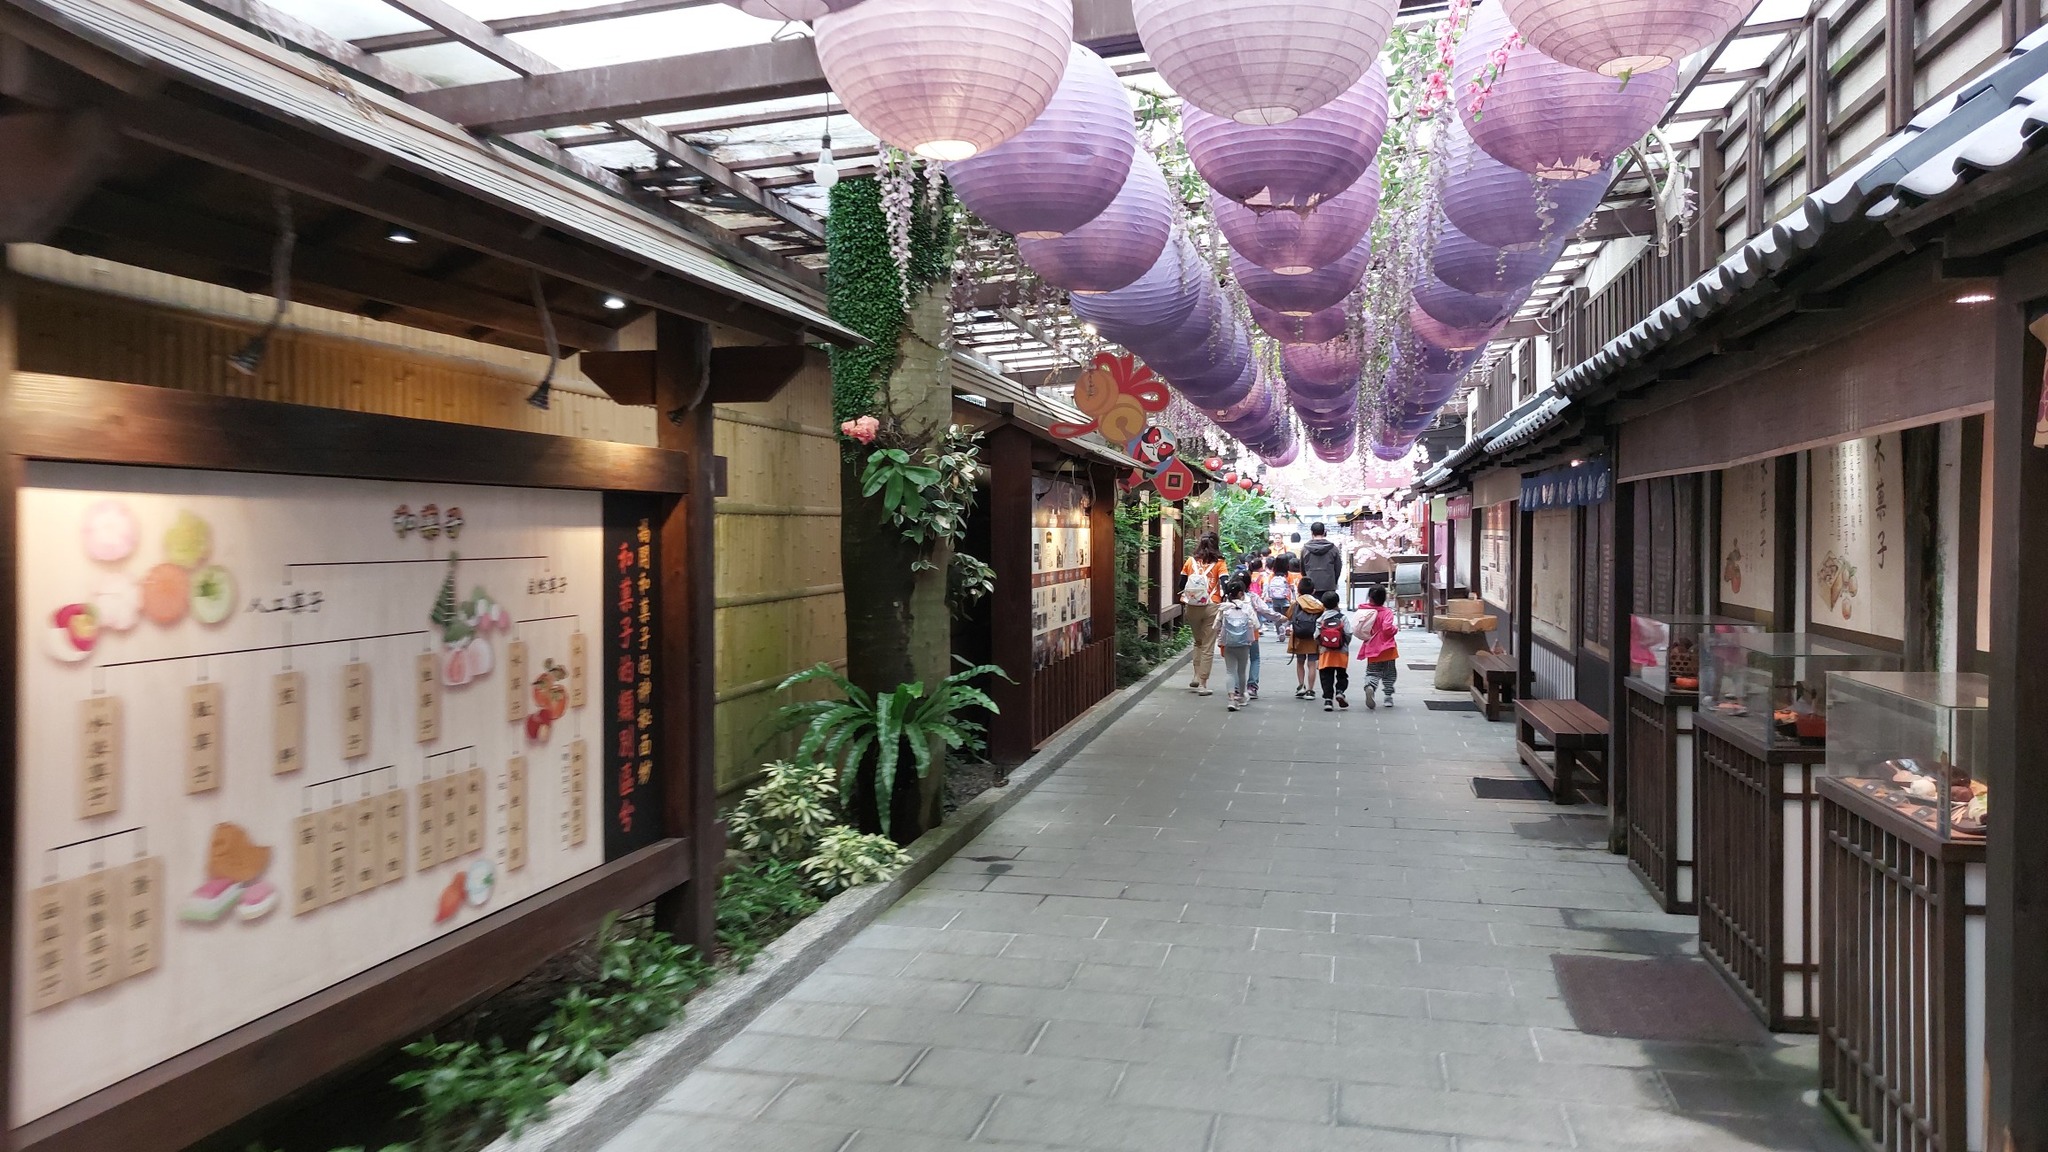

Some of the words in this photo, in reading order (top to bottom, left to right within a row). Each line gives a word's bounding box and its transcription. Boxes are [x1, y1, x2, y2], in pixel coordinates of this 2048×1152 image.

[393, 503, 464, 540] 和菓子
[617, 541, 636, 833] 和菓子的類別區分
